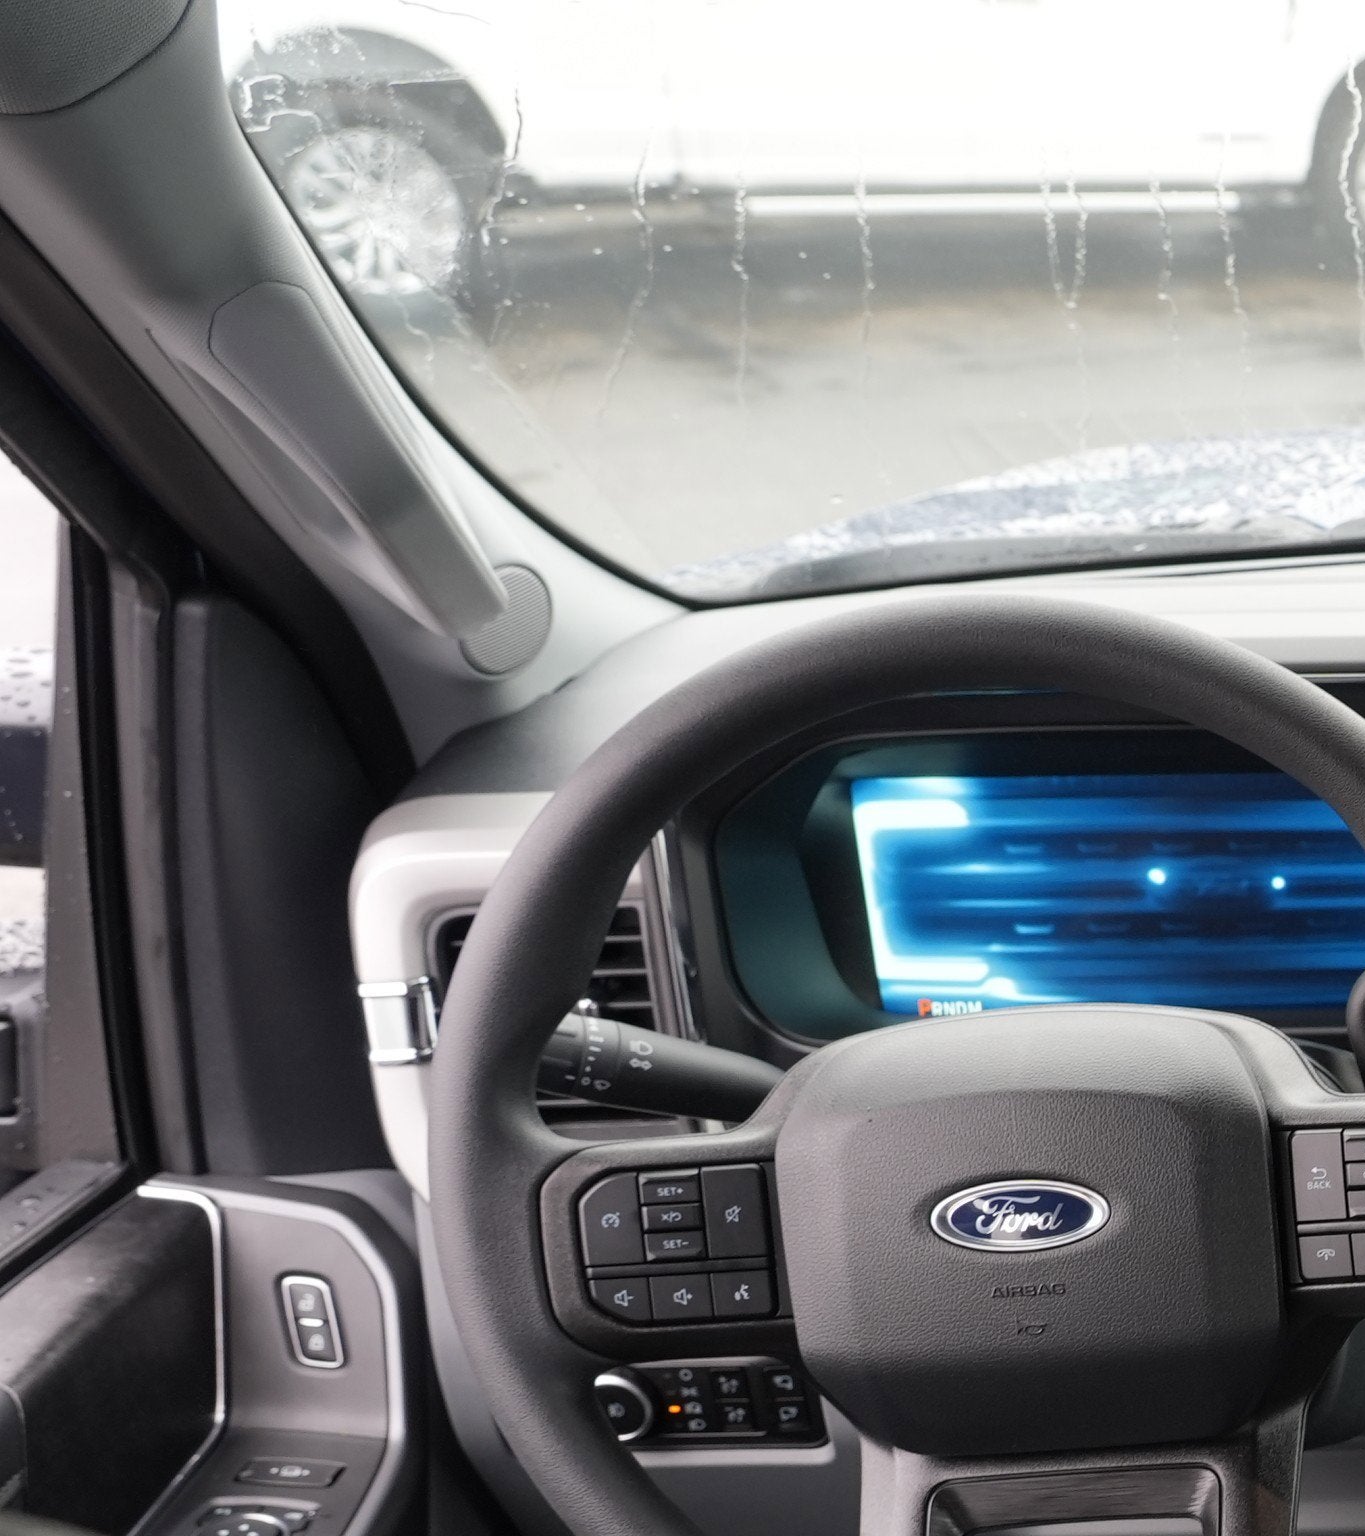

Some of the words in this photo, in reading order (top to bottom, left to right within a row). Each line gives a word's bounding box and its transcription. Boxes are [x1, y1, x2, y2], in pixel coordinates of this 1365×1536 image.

[1307, 1180, 1331, 1190] BACK
[973, 1195, 1064, 1234] Ford
[991, 1284, 1066, 1299] AIRBAG
